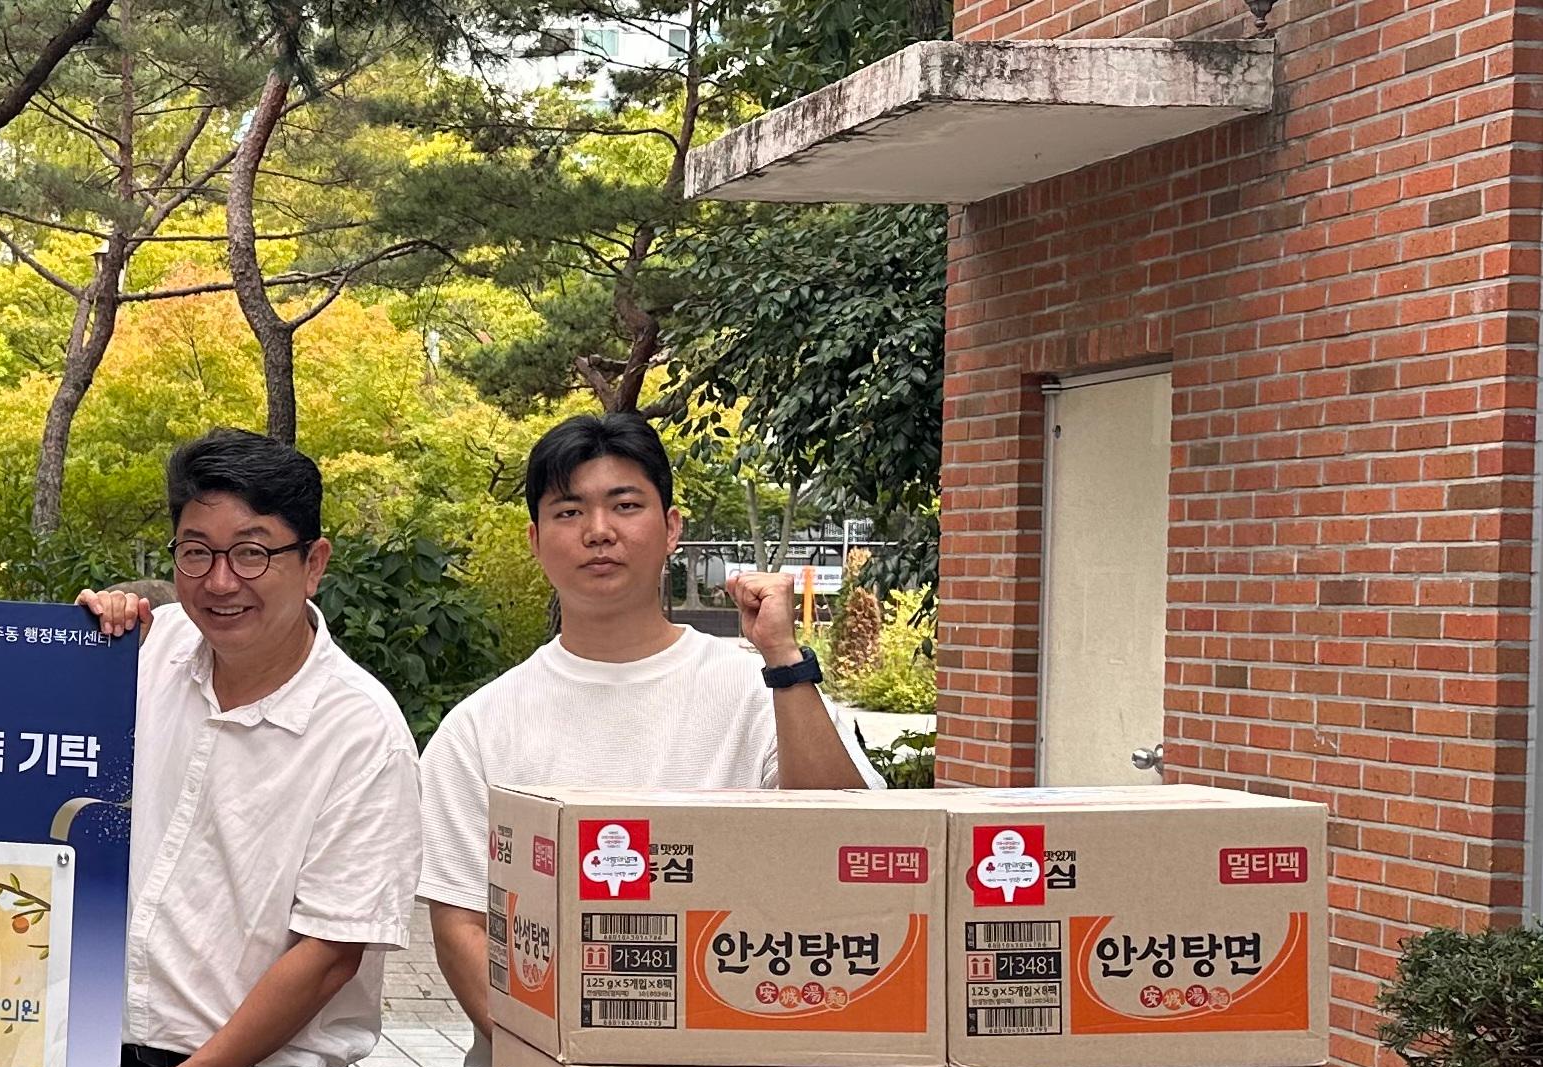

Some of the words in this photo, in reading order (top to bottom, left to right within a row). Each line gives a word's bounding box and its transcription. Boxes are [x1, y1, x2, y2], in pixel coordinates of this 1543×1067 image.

[18, 731, 102, 778] 기탁
[846, 851, 919, 878] 멀티팩
[1227, 850, 1299, 880] 멀티팩
[615, 948, 673, 969] 가3481
[711, 931, 880, 976] 안성탕면
[999, 955, 1057, 976] 가3481
[1095, 932, 1262, 979] 안성탕면
